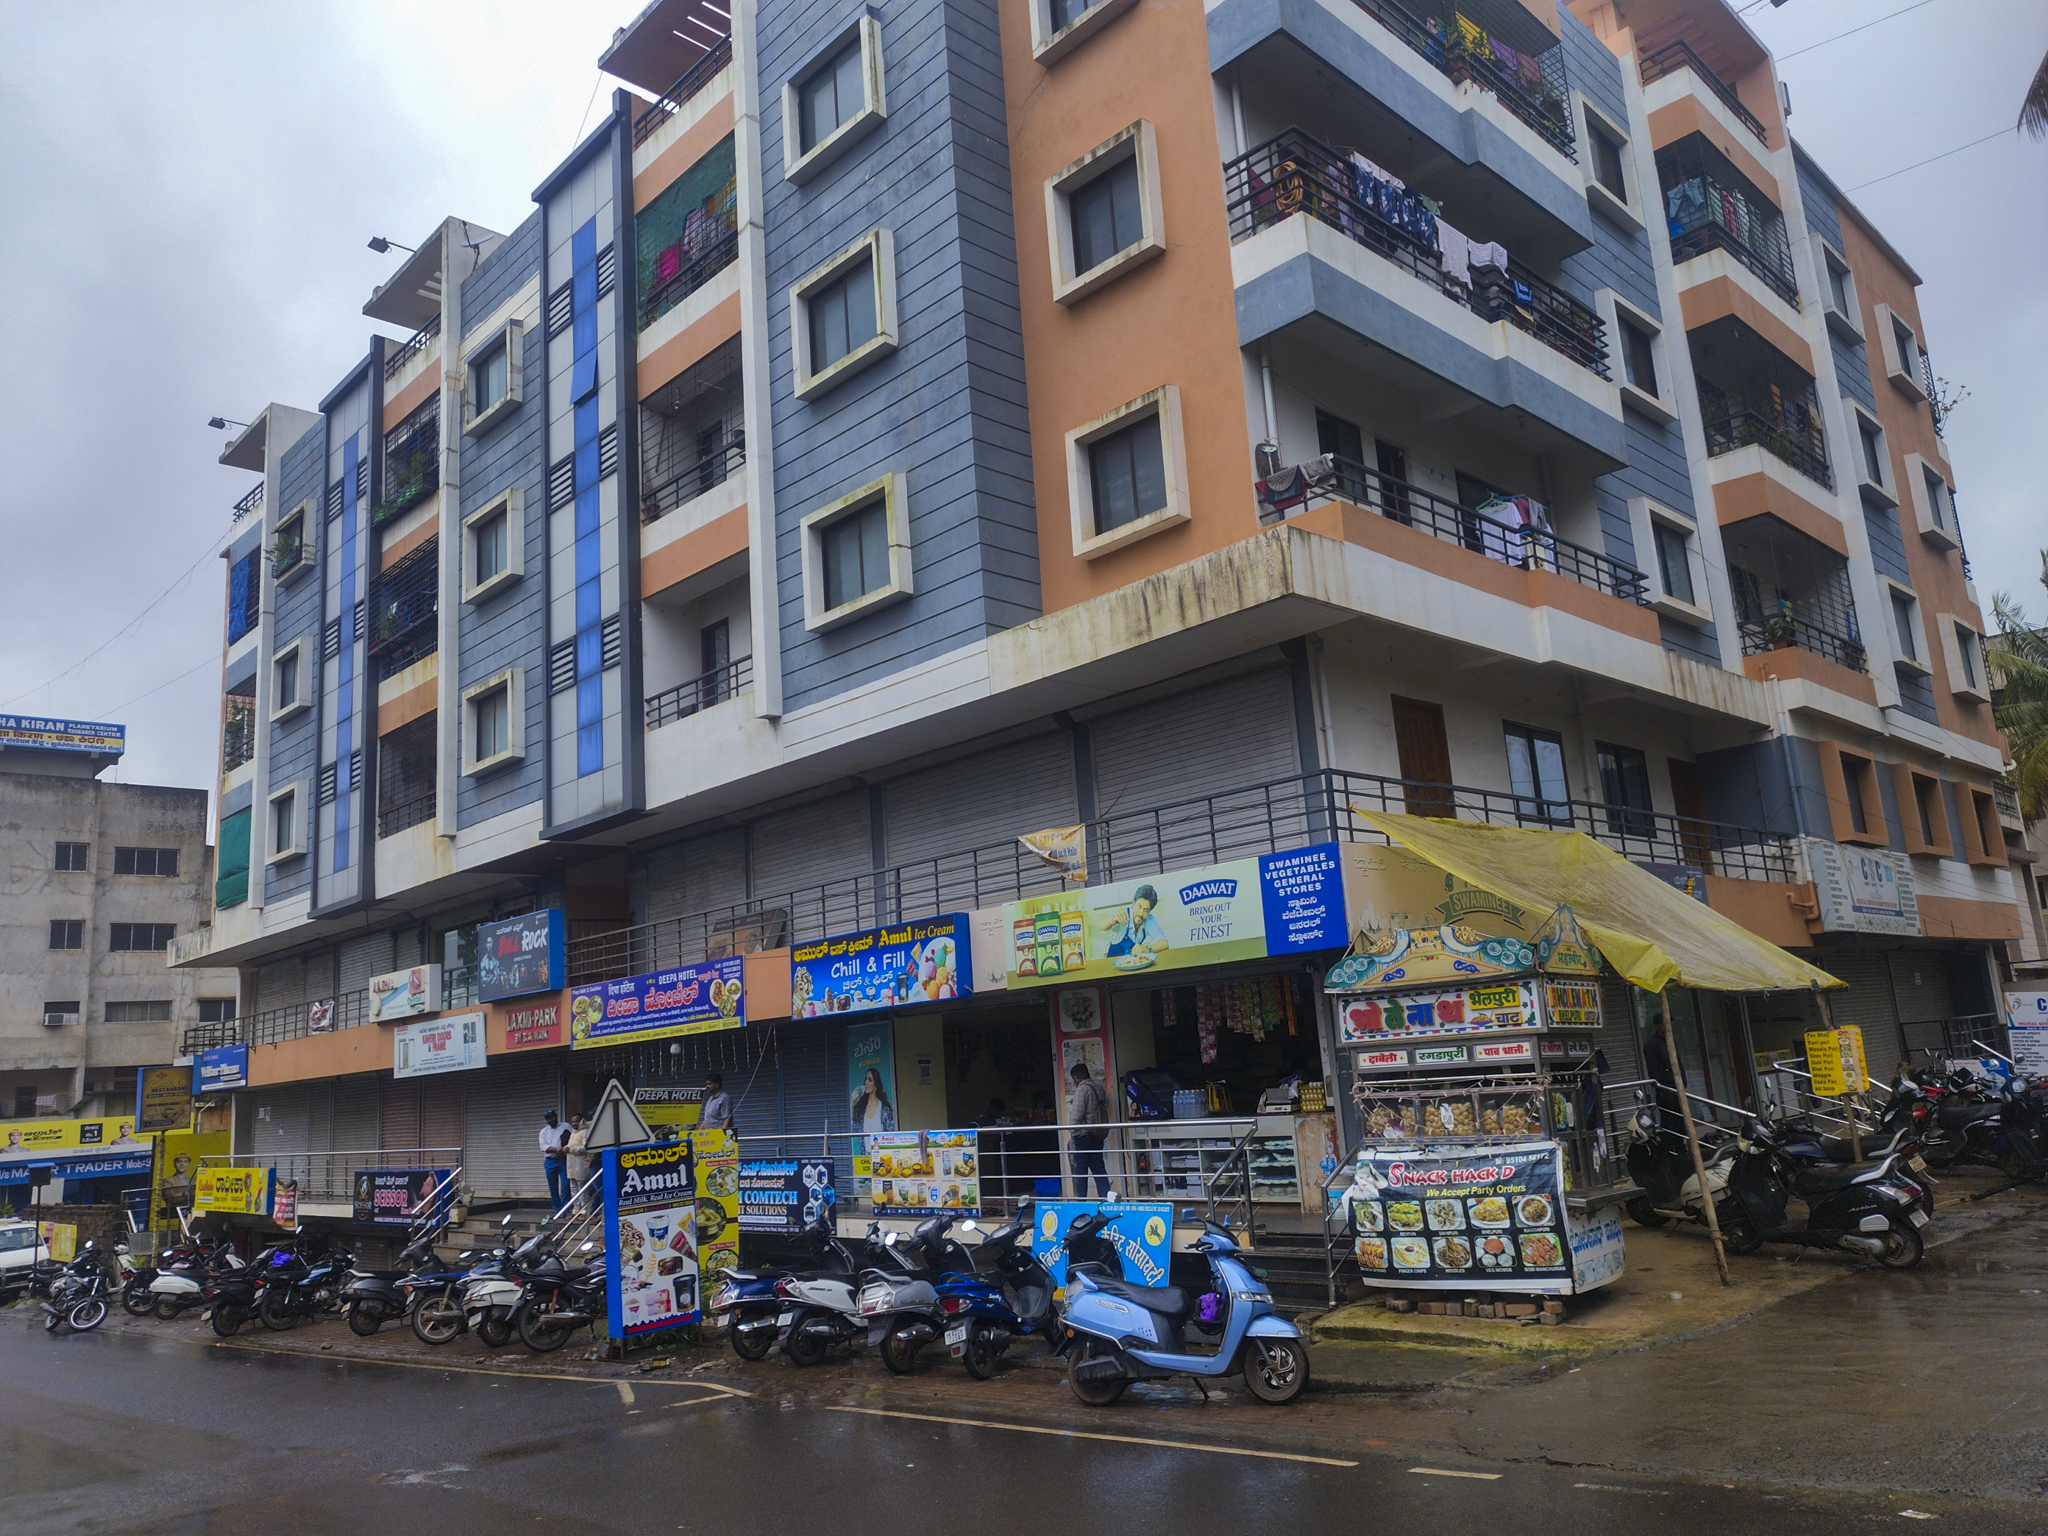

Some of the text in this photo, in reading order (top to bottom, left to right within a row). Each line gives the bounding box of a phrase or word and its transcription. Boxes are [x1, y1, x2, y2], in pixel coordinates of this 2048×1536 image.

[21, 719, 65, 731] KIRAN
[67, 728, 95, 736] RESEARCH
[68, 723, 118, 732] PLANETARIUM
[1269, 853, 1327, 870] SWAMINEE
[1265, 861, 1336, 880] VEGETABLES
[1274, 872, 1325, 888] GENERAL
[1182, 882, 1236, 903] DAAWAT
[1278, 882, 1322, 896] STORES
[1189, 902, 1232, 917] BRING OUT
[1454, 892, 1509, 913] SWAMINEE
[1200, 913, 1222, 925] YOUR
[878, 924, 955, 949] Amul Ice Cream
[1189, 922, 1233, 942] FINEST
[498, 934, 520, 957] BULL
[521, 927, 549, 952] ROCK
[794, 942, 829, 962] ಅಮುಲ್
[829, 940, 847, 956] ಐಸ್
[831, 950, 905, 979] Chill & Fill
[658, 973, 678, 985] DEEPA
[678, 969, 698, 981] HOTEL
[1468, 987, 1517, 1008] भेलपुरी
[1550, 986, 1598, 1008] BHOLENATH
[506, 1006, 558, 1032] LAXMI-PARK
[1494, 1011, 1521, 1025] चाट
[422, 1030, 452, 1044] KAVERI DOORS
[433, 1041, 446, 1052] FRAME
[1417, 1046, 1465, 1063] रगडापुरी
[1483, 1043, 1524, 1057] पाव भाजी
[637, 1091, 702, 1101] DEEPA HOTEL
[621, 1142, 688, 1168] ಅಮುಲ್
[1505, 1156, 1527, 1165] 95104
[64, 1160, 123, 1174] TRADER
[1388, 1162, 1516, 1187] SNACK HACK D
[621, 1163, 688, 1197] Amul
[374, 1189, 408, 1207] SCISSOR
[618, 1198, 632, 1207] Real
[650, 1193, 664, 1201] Real
[664, 1191, 673, 1199] Ice
[673, 1190, 693, 1198] Cream
[744, 1191, 798, 1205] COMTECH
[1426, 1184, 1527, 1198] We Accept Party Orders
[354, 1201, 372, 1210] SCISSOR
[746, 1205, 787, 1215] SOLUTIONS
